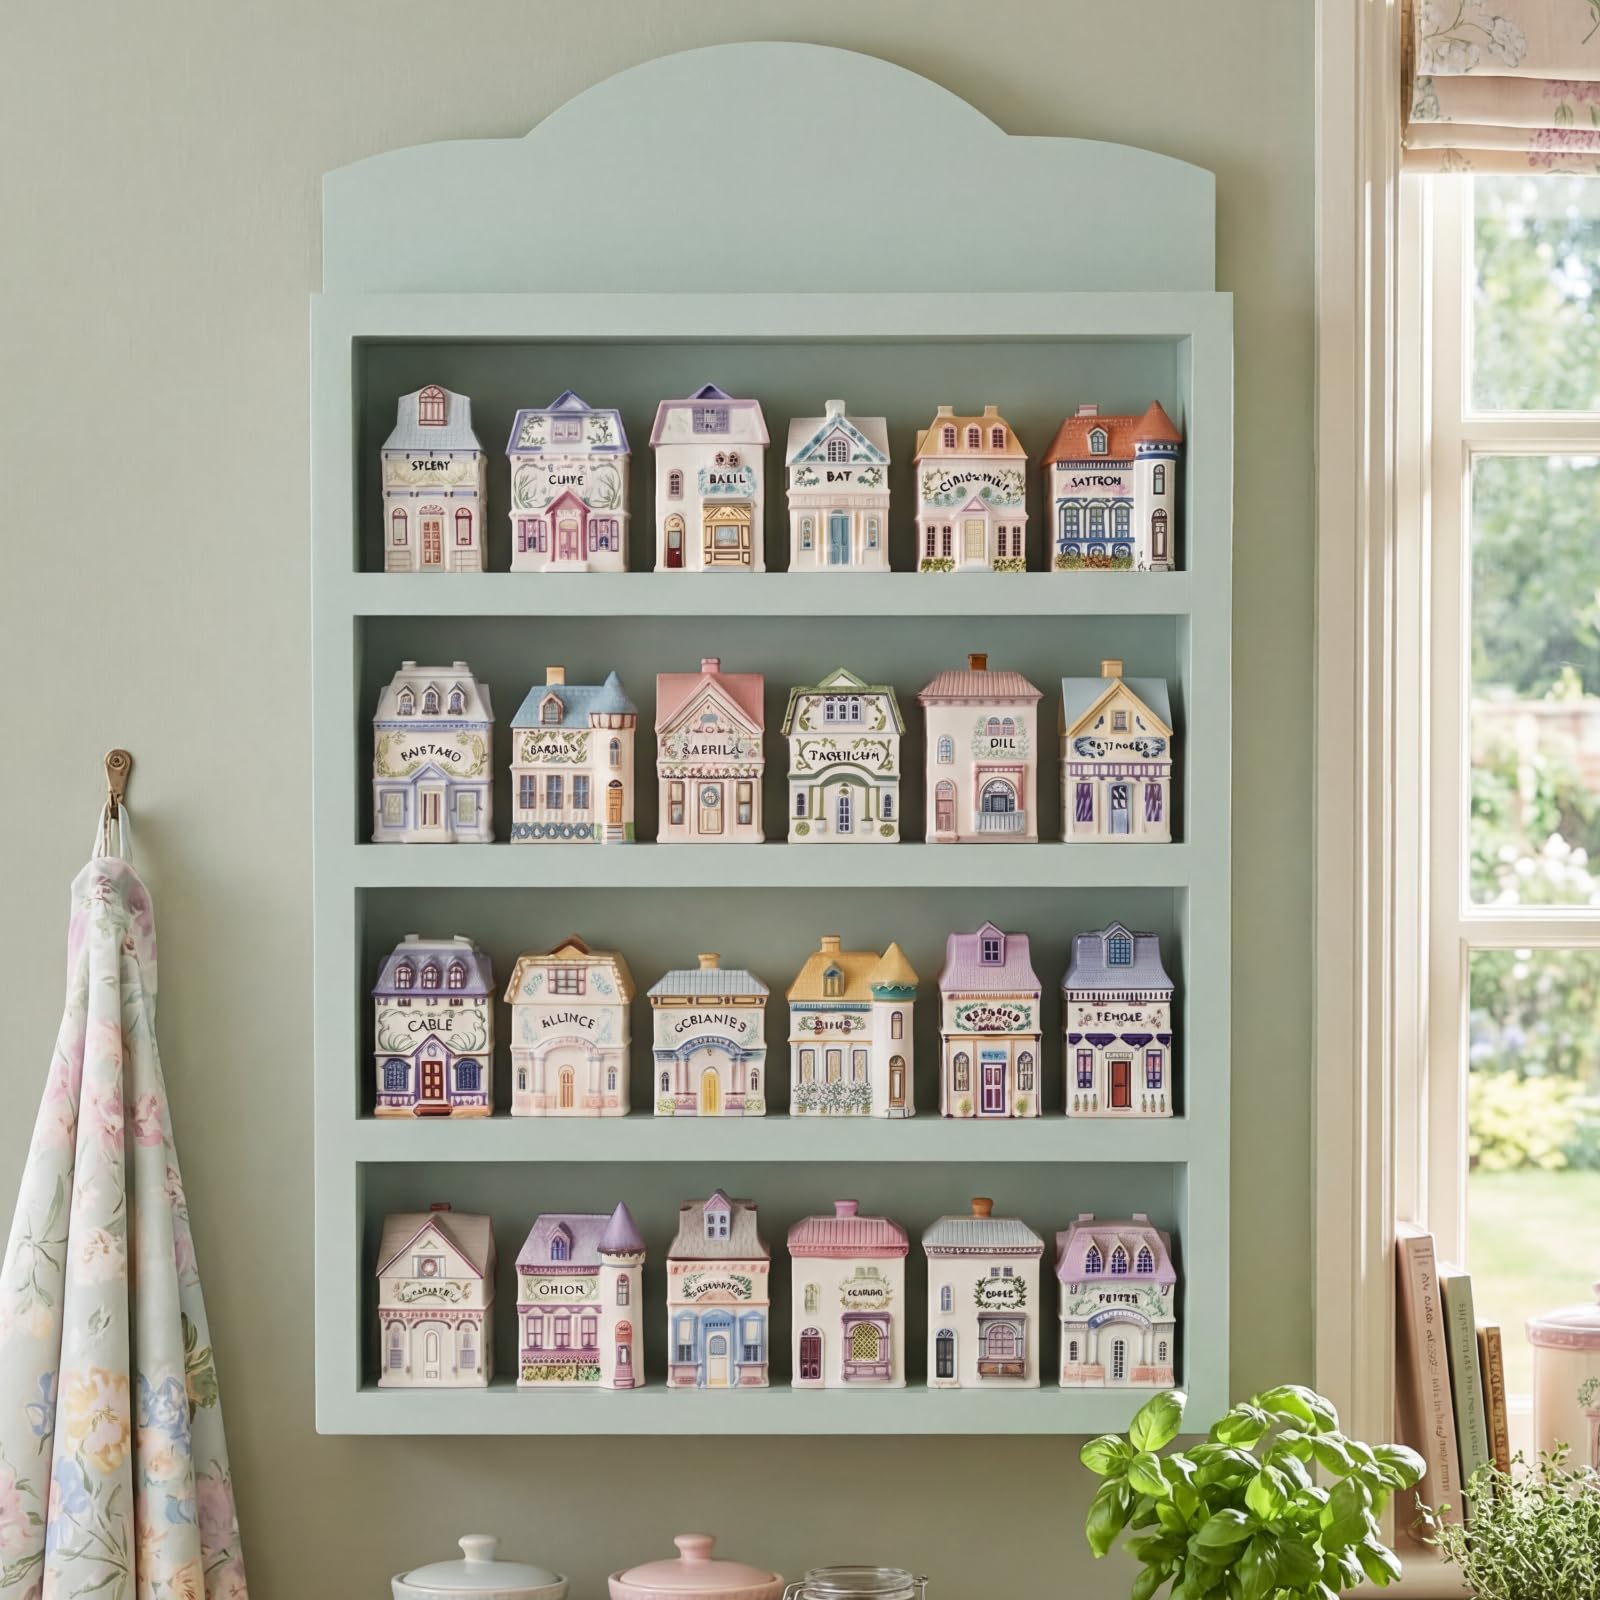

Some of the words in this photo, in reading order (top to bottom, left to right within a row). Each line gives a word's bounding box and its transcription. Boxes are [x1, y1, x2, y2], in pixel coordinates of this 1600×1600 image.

[826, 471, 852, 482] BAT
[990, 738, 1016, 749] DILL
[407, 1018, 453, 1032] CABLE
